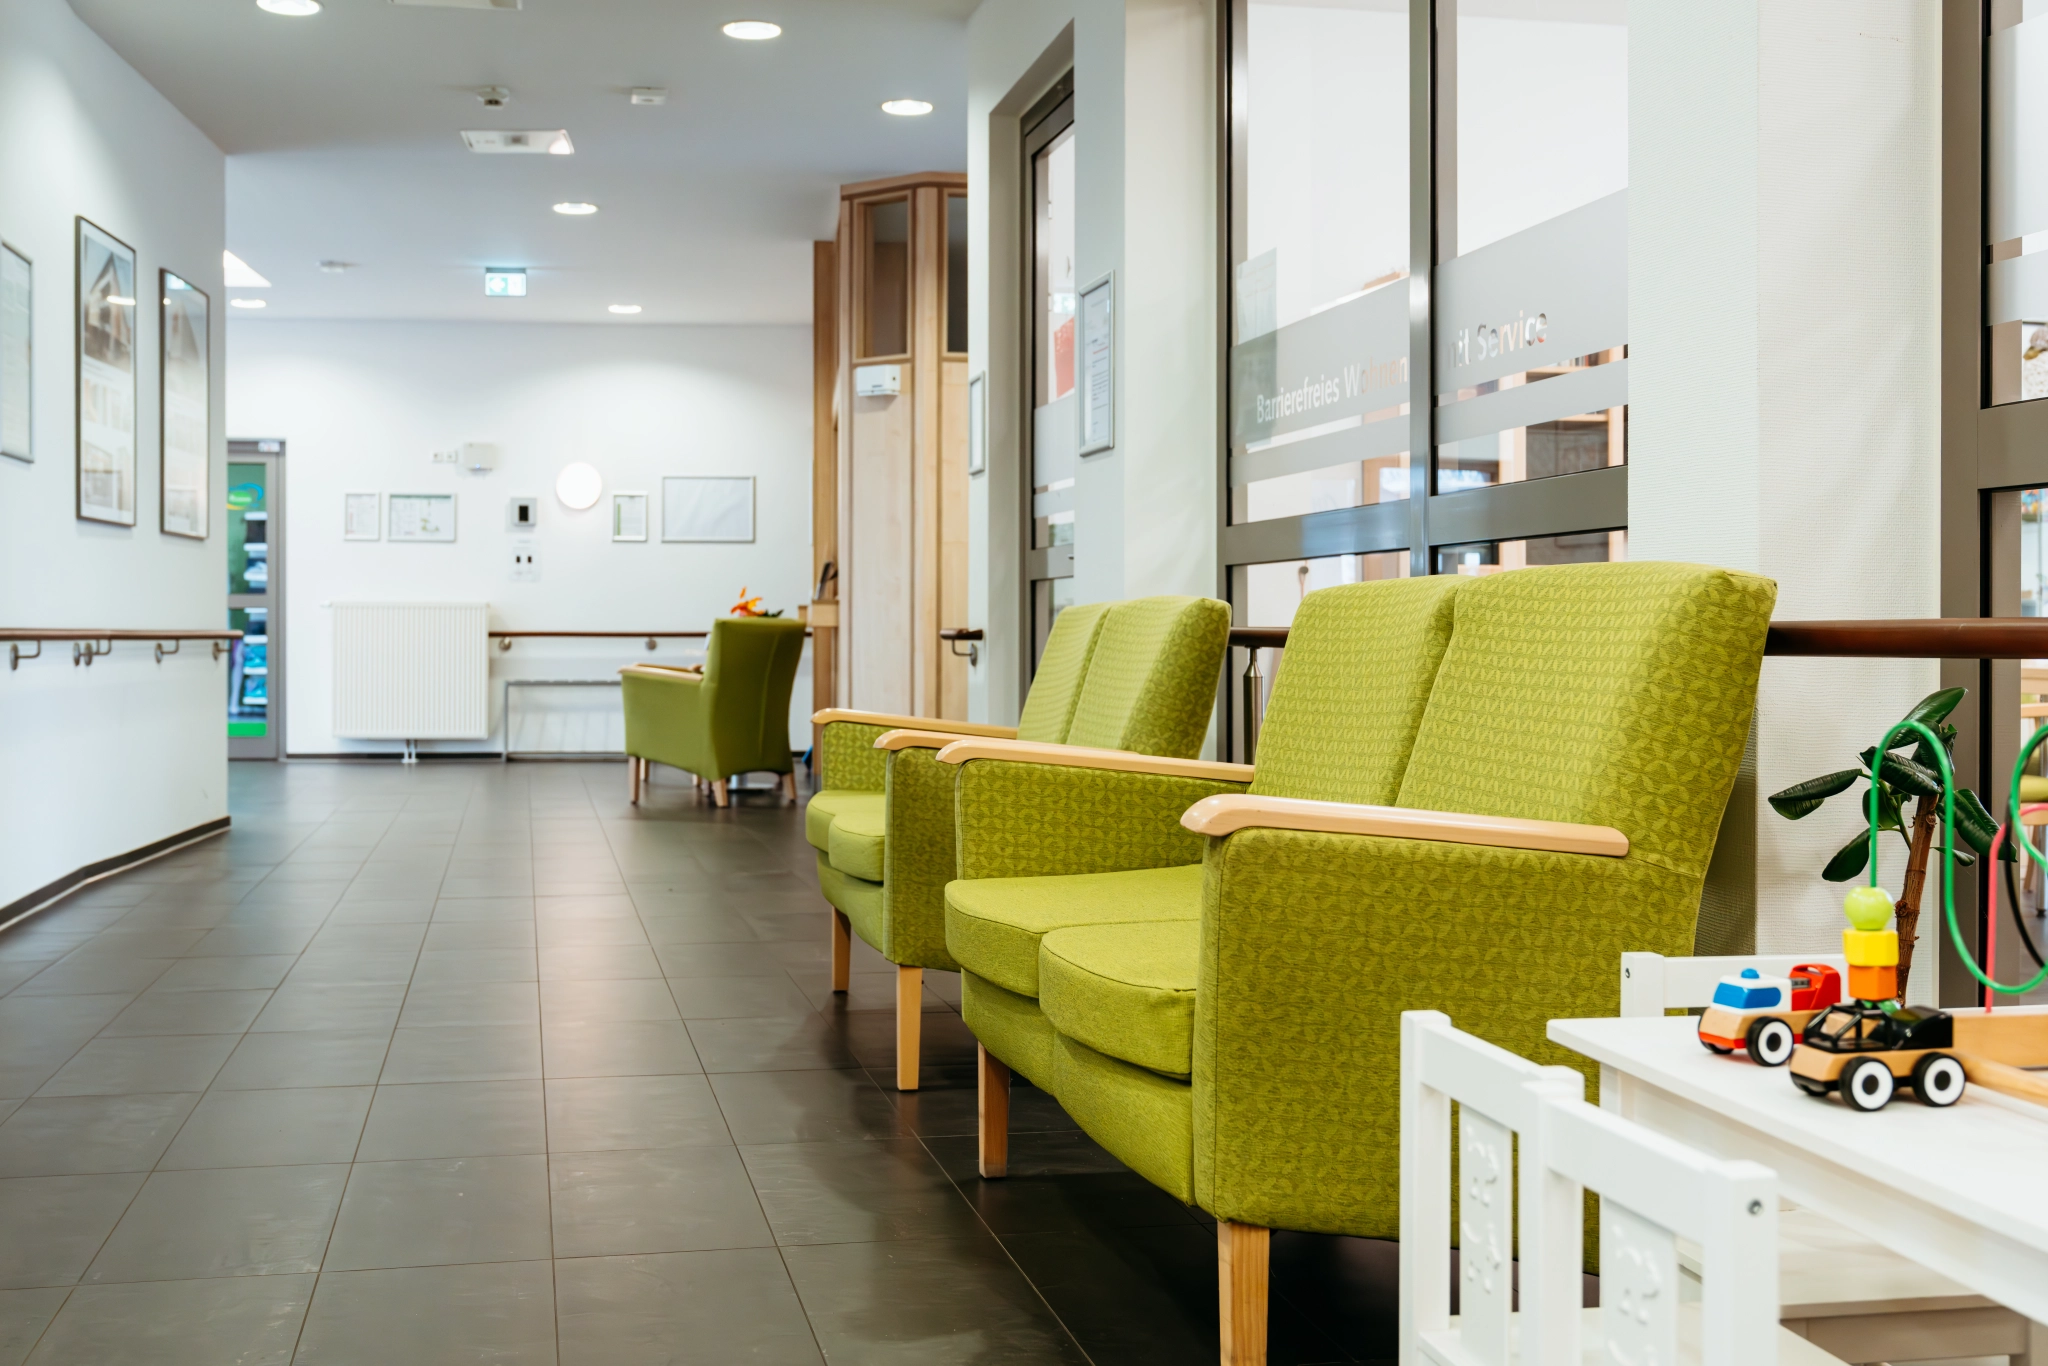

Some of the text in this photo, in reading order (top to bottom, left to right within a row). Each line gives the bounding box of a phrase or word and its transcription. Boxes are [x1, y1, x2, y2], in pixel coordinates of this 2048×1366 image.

[1256, 374, 1340, 424] Barrierefreies
[1343, 356, 1408, 398] Wohnen
[1477, 309, 1548, 361] Service
